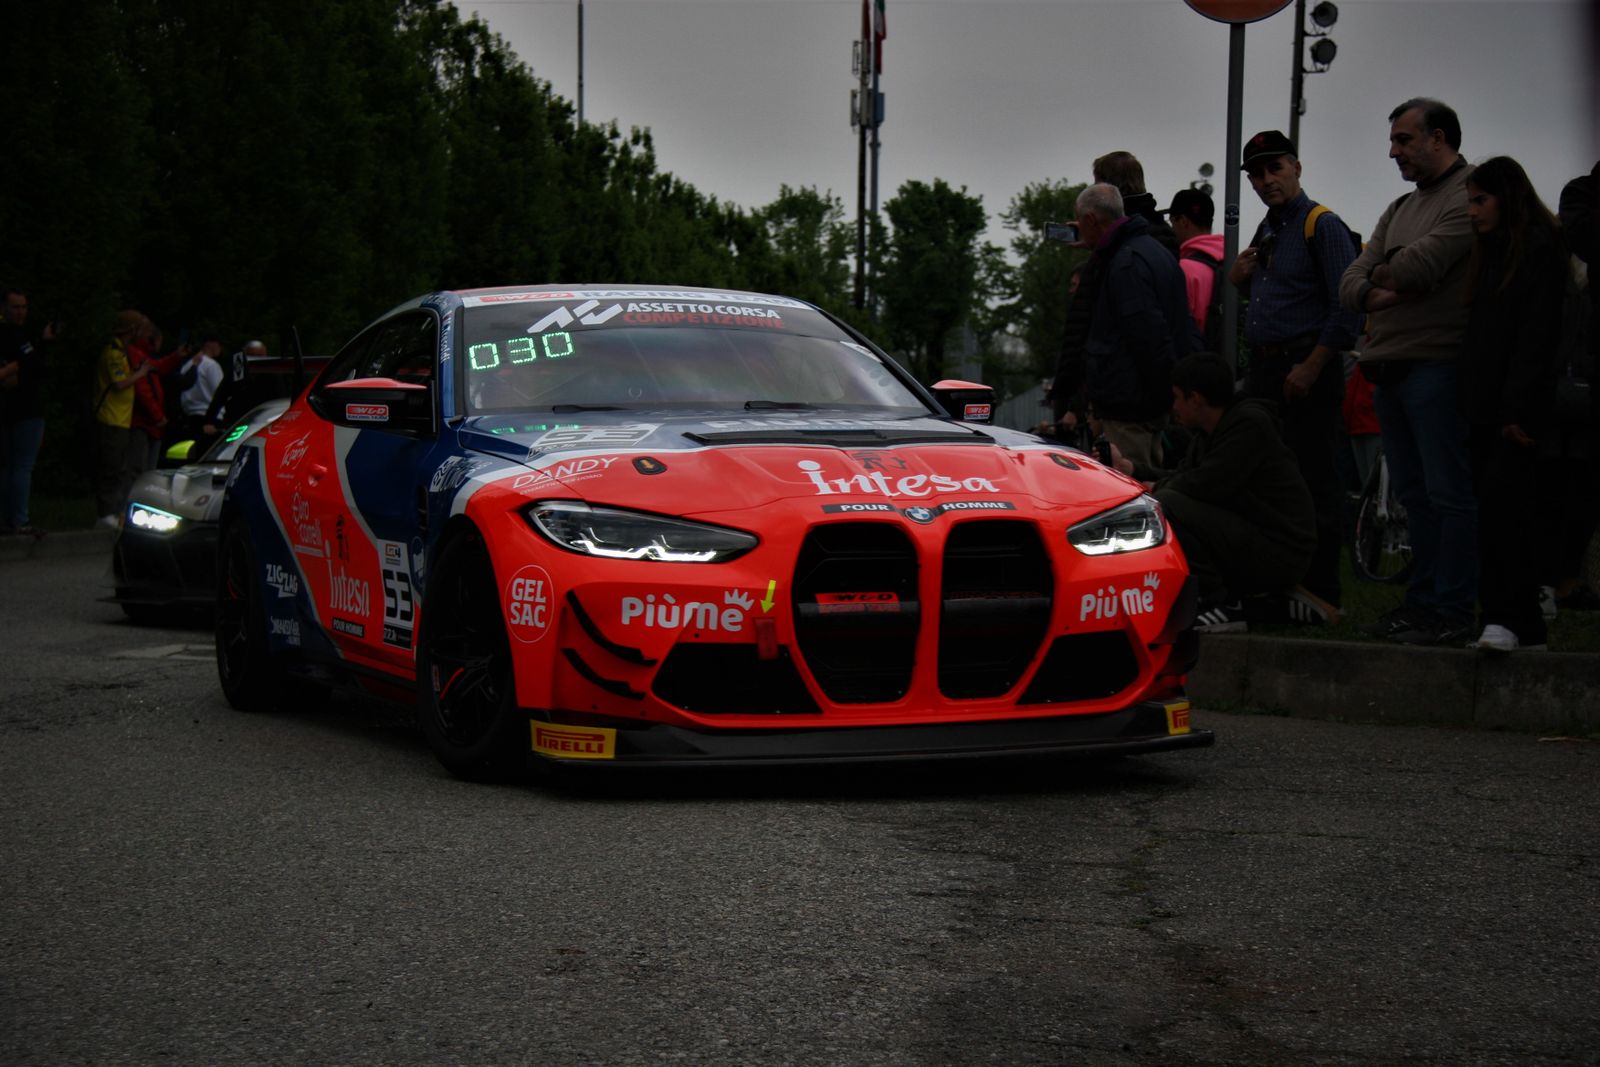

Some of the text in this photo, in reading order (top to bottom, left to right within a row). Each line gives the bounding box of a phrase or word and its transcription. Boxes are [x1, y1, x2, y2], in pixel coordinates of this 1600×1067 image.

[580, 291, 703, 299] RACING
[623, 312, 785, 329] COMPETIZIONE
[627, 302, 781, 319] ASSETTO CORSA
[469, 332, 574, 370] 030
[512, 457, 618, 488] DANDY
[942, 502, 1007, 510] HOMME
[382, 569, 414, 621] 53
[511, 578, 544, 602] GEL
[510, 602, 546, 628] SAC
[536, 728, 606, 754] PIRELLI
